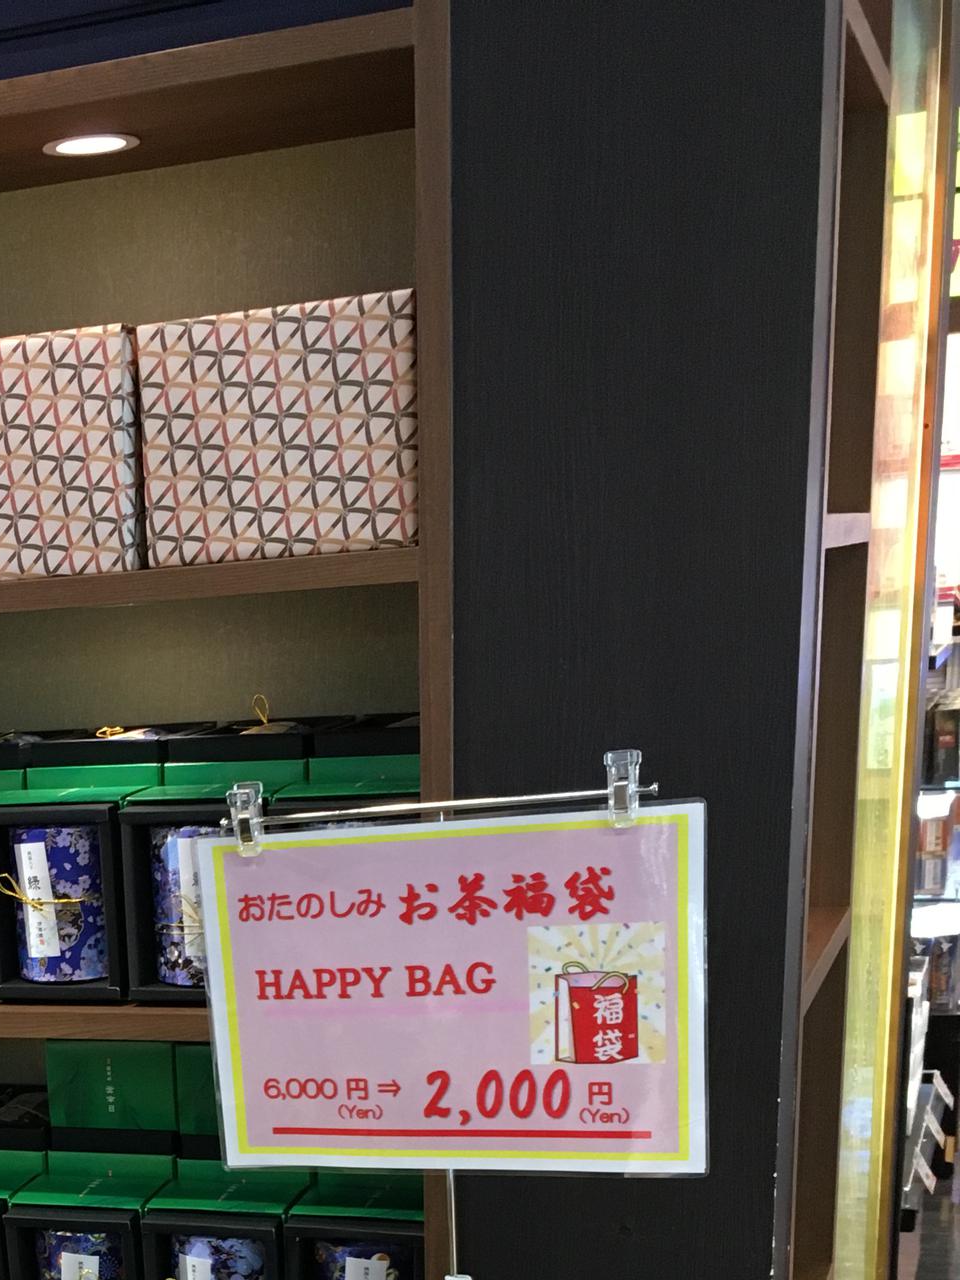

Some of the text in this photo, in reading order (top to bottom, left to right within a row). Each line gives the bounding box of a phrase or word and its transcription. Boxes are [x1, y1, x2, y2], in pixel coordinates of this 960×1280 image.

[237, 889, 386, 922] おたのしみ
[398, 866, 616, 926] お茶福袋
[255, 961, 497, 1001] HAPPY BAG
[593, 993, 625, 1062] 福袋
[338, 1104, 630, 1125] (Yen) (Yen)
[423, 1069, 572, 1126] 2,000
